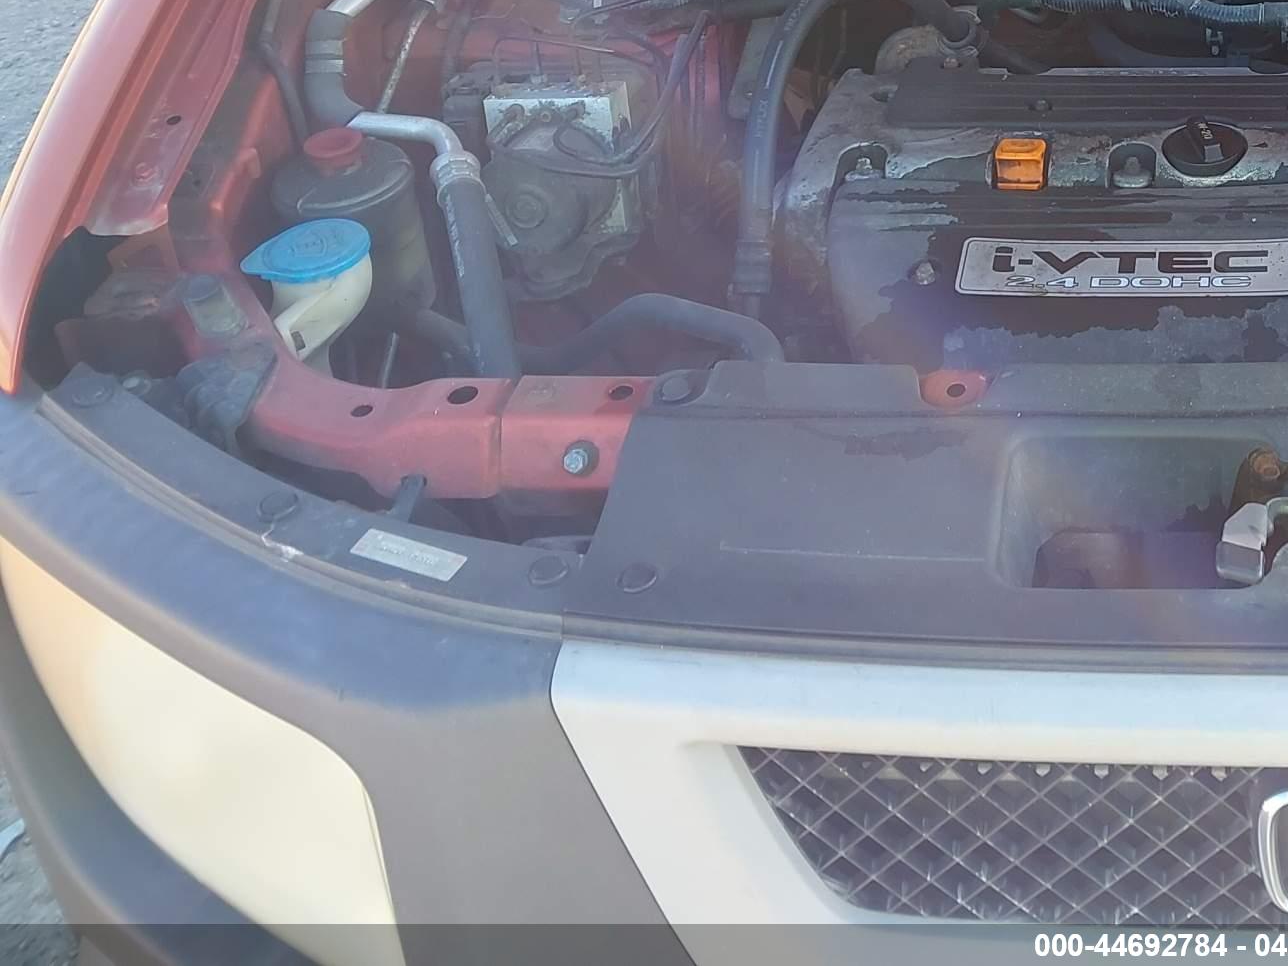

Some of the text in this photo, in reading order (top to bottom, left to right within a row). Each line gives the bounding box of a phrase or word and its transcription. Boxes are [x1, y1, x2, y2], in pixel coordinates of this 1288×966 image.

[991, 245, 1269, 275] i-VTEC
[1004, 274, 1252, 289] 2.4 DOHC
